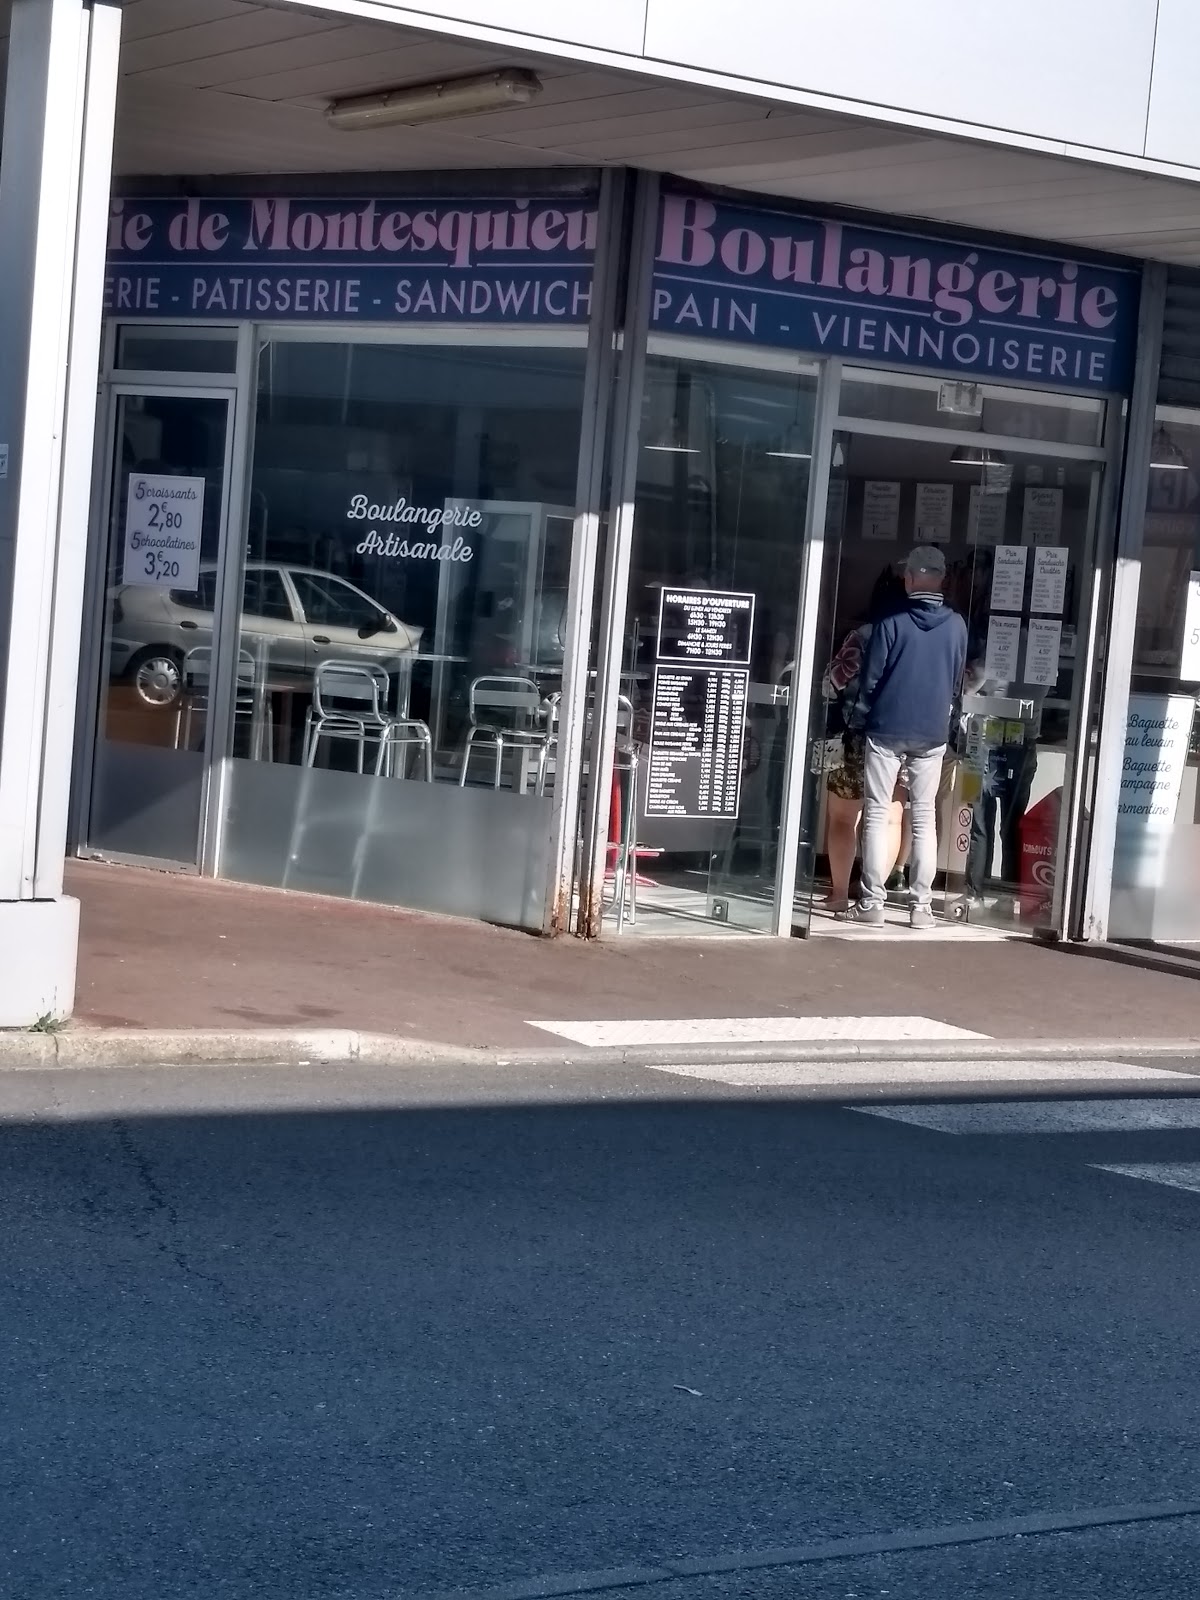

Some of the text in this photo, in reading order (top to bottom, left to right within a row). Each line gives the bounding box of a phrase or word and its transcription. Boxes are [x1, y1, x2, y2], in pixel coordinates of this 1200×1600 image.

[168, 199, 230, 251] de
[243, 199, 598, 268] Montesquieu
[655, 194, 1118, 328] Boulangerie
[192, 277, 361, 313] PATISSERIE
[652, 289, 757, 335] PAIN
[812, 311, 1106, 382] VIENNOISERIE
[135, 481, 197, 500] 5 croissants
[346, 494, 483, 534] Boulangerie
[131, 531, 196, 551] 5 chocolatines
[356, 530, 474, 562] Artisanale
[666, 594, 701, 605] HORAIRES
[1127, 713, 1179, 733] Baguette
[1125, 733, 1175, 748] au levain
[1123, 756, 1172, 777] Baguette
